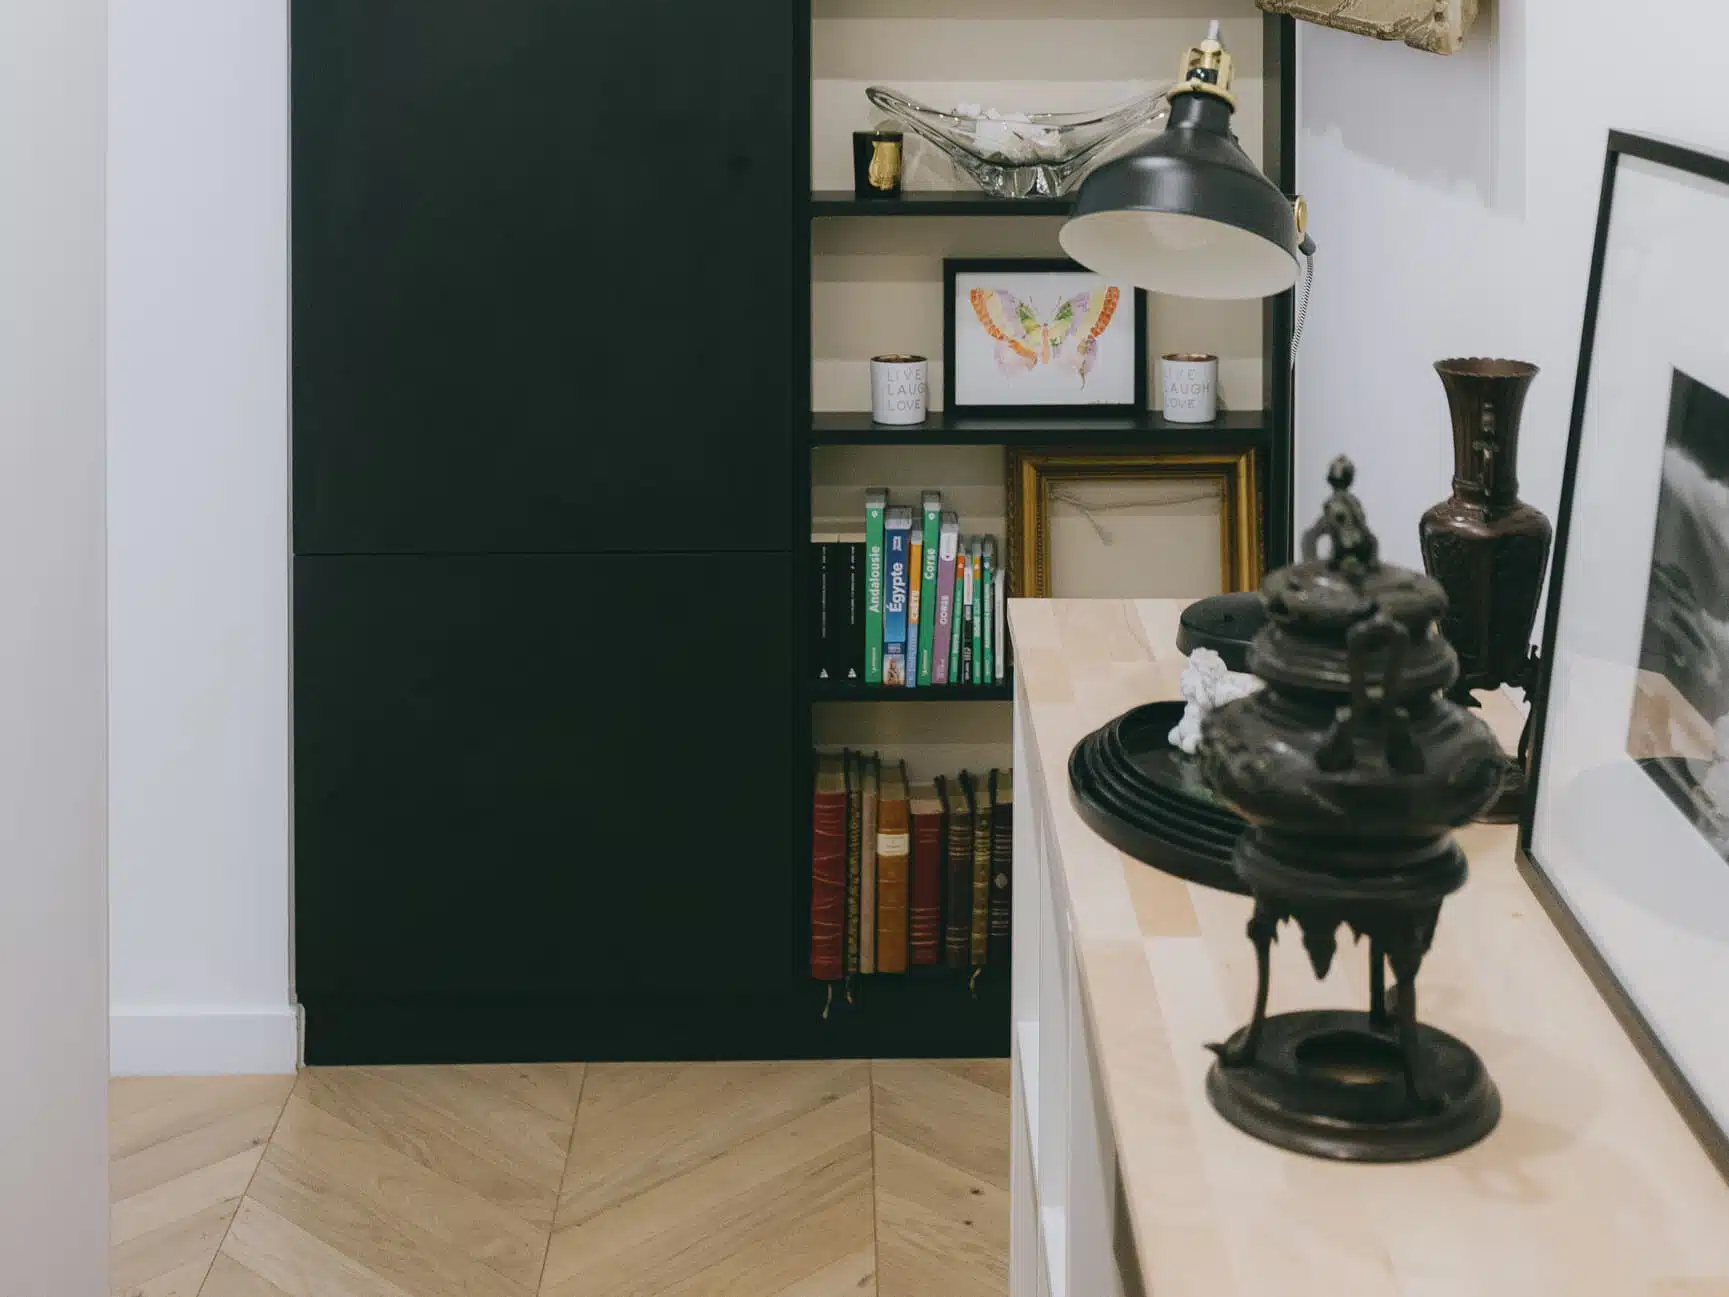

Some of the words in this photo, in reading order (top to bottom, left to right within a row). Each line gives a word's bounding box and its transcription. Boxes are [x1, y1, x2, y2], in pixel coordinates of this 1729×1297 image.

[887, 367, 921, 382] LIVE
[887, 383, 927, 395] LAUG
[887, 399, 921, 411] LOVE
[925, 548, 936, 580] Corse
[869, 546, 880, 613] Andalousie
[886, 562, 904, 613] Égypte
